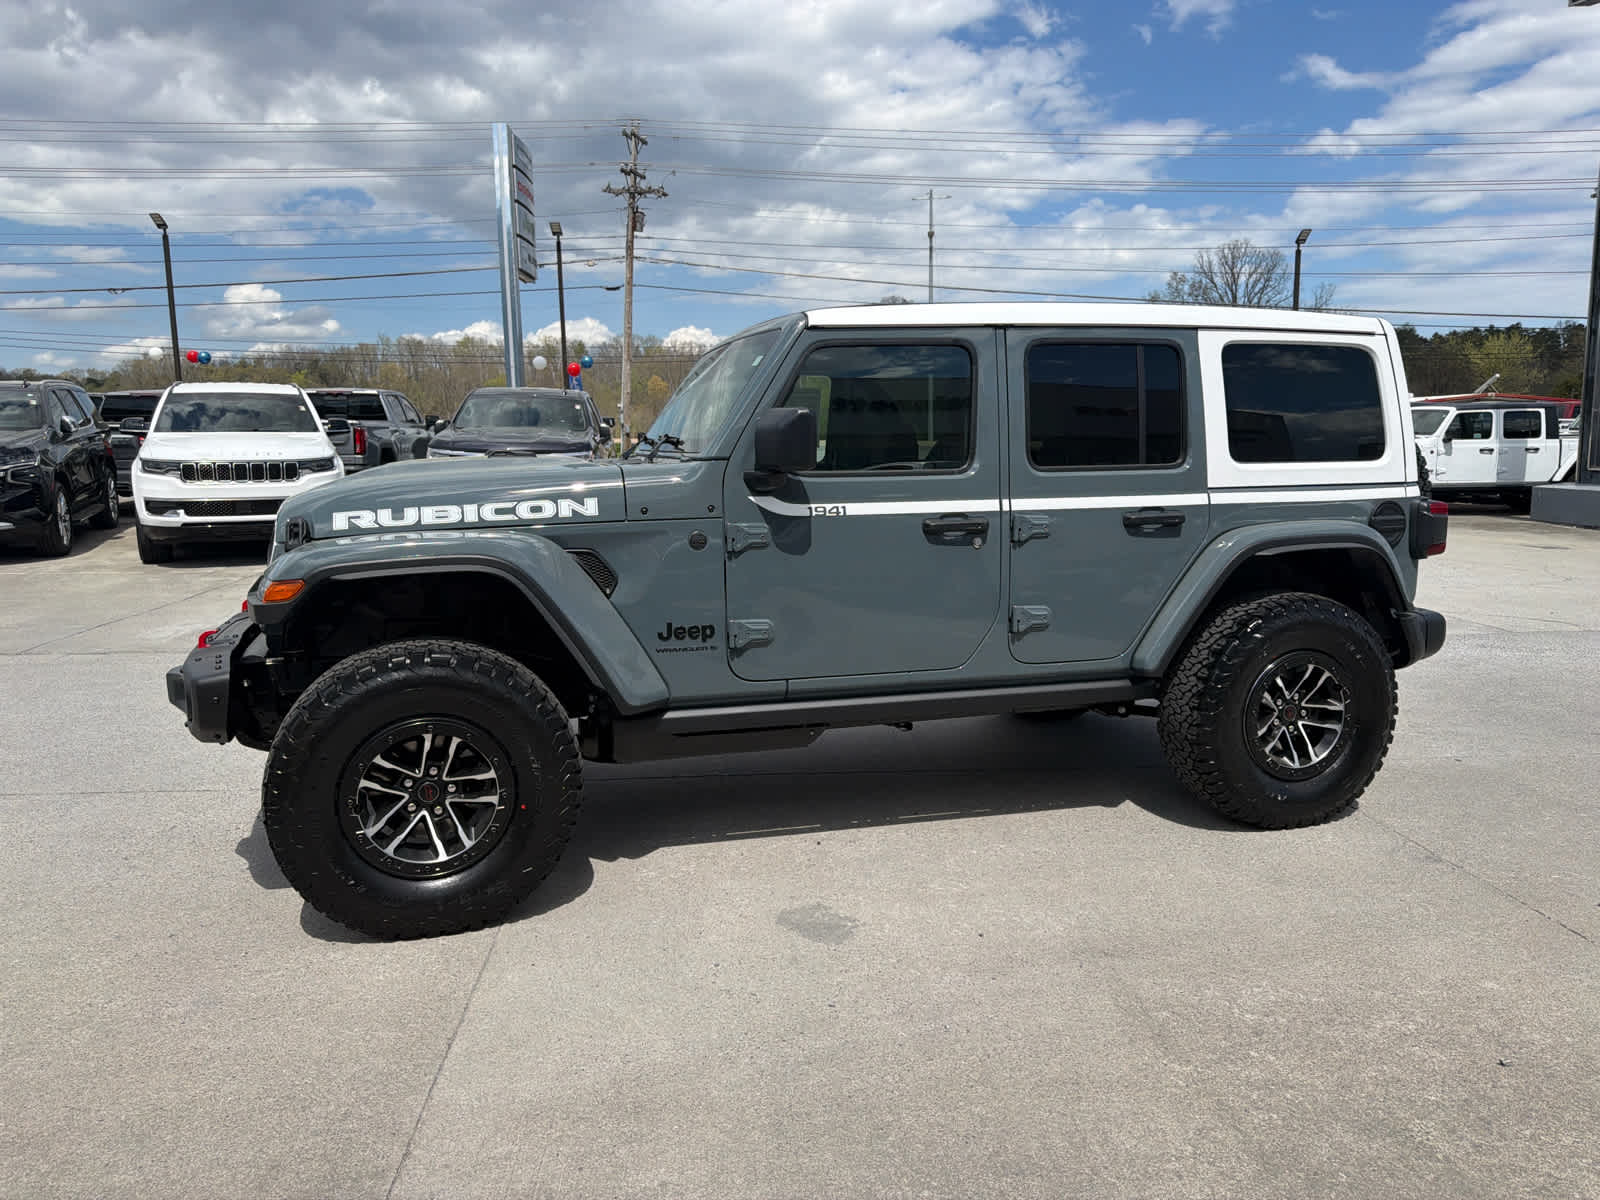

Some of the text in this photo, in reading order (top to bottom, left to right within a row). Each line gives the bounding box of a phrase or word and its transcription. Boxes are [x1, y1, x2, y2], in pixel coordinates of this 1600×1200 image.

[332, 497, 599, 531] RUBICON
[808, 505, 847, 517] 1941
[657, 622, 716, 643] Jeep
